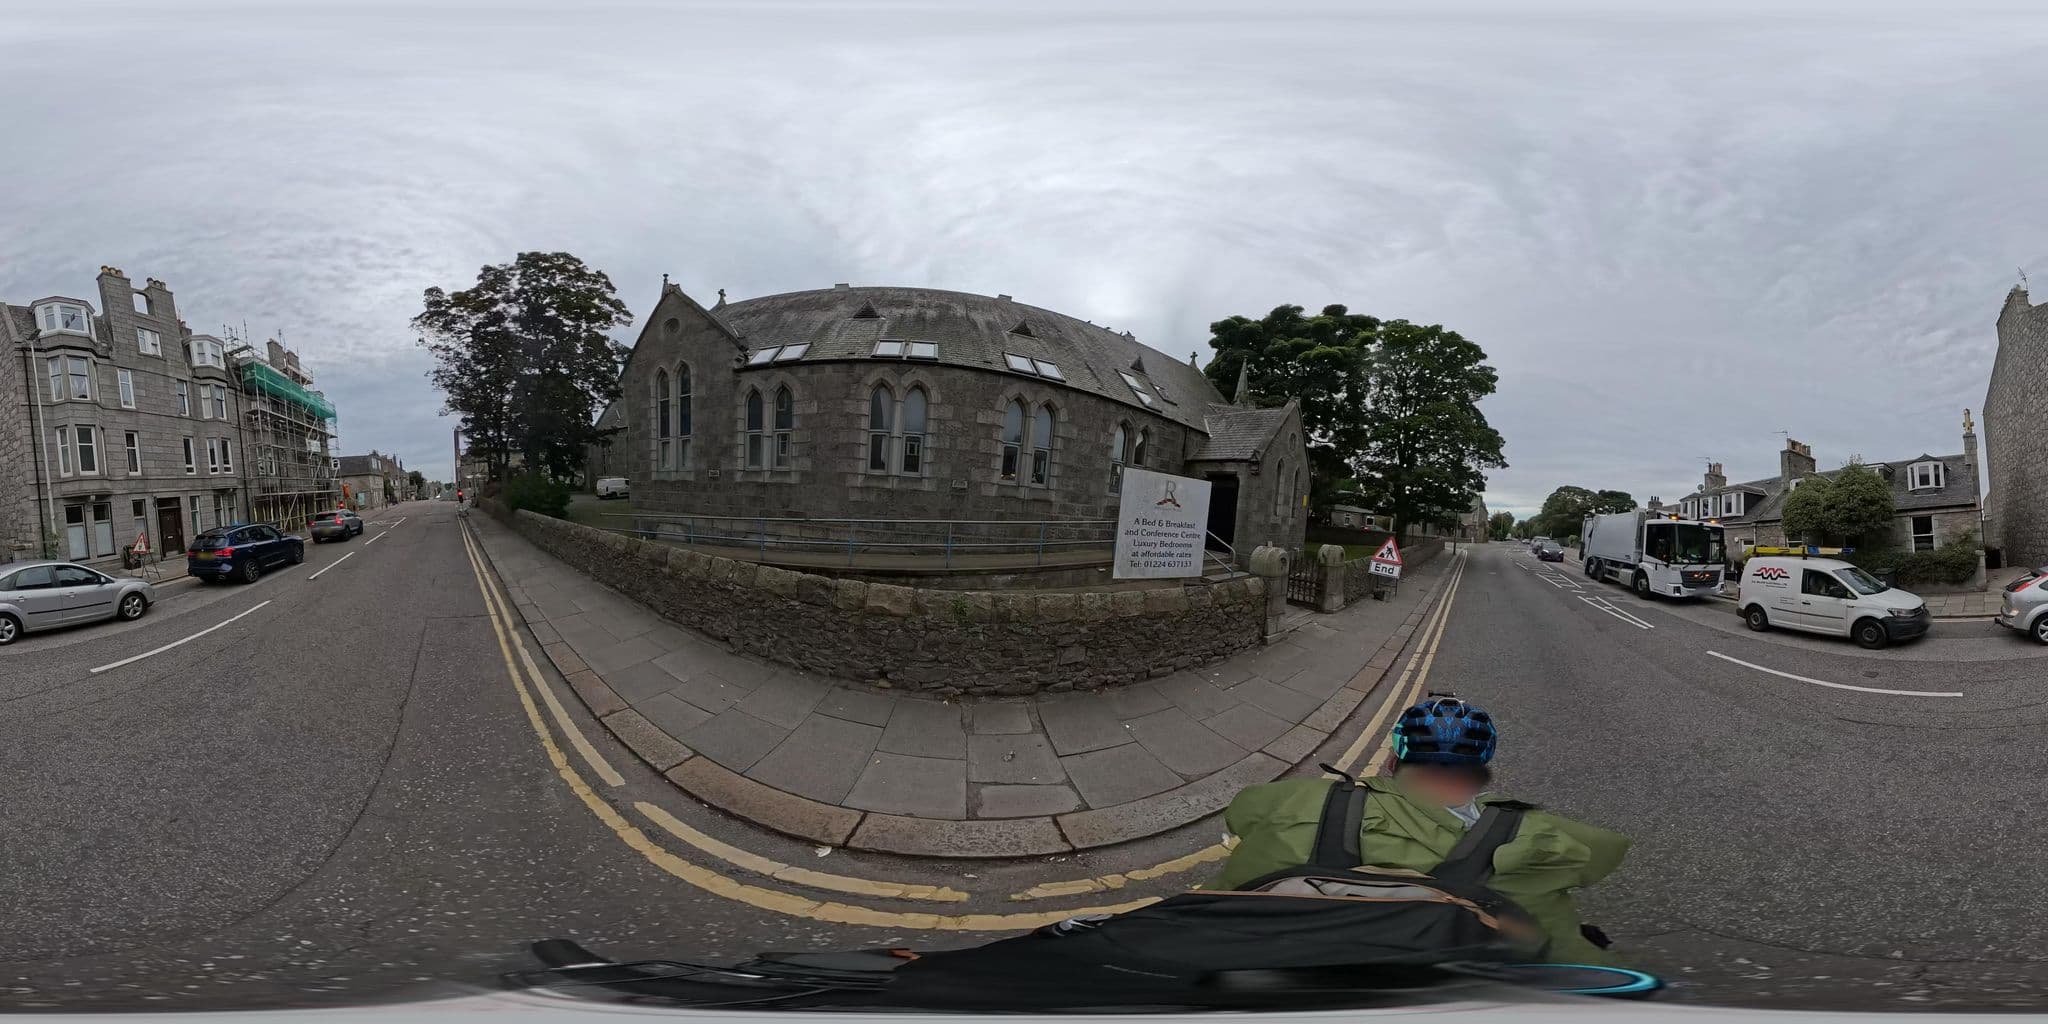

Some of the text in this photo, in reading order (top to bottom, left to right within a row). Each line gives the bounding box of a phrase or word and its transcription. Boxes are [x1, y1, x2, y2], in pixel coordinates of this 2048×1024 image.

[1142, 518, 1156, 526] Bed
[1158, 519, 1164, 527] &
[1166, 521, 1196, 529] Breakfast
[1124, 528, 1201, 540] and Conference Centre
[1133, 539, 1193, 549] Luxury Bedrooms
[1140, 549, 1175, 558] affordable
[1129, 560, 1142, 568] Tel:
[1143, 560, 1166, 568] 01224
[1374, 563, 1394, 574] End
